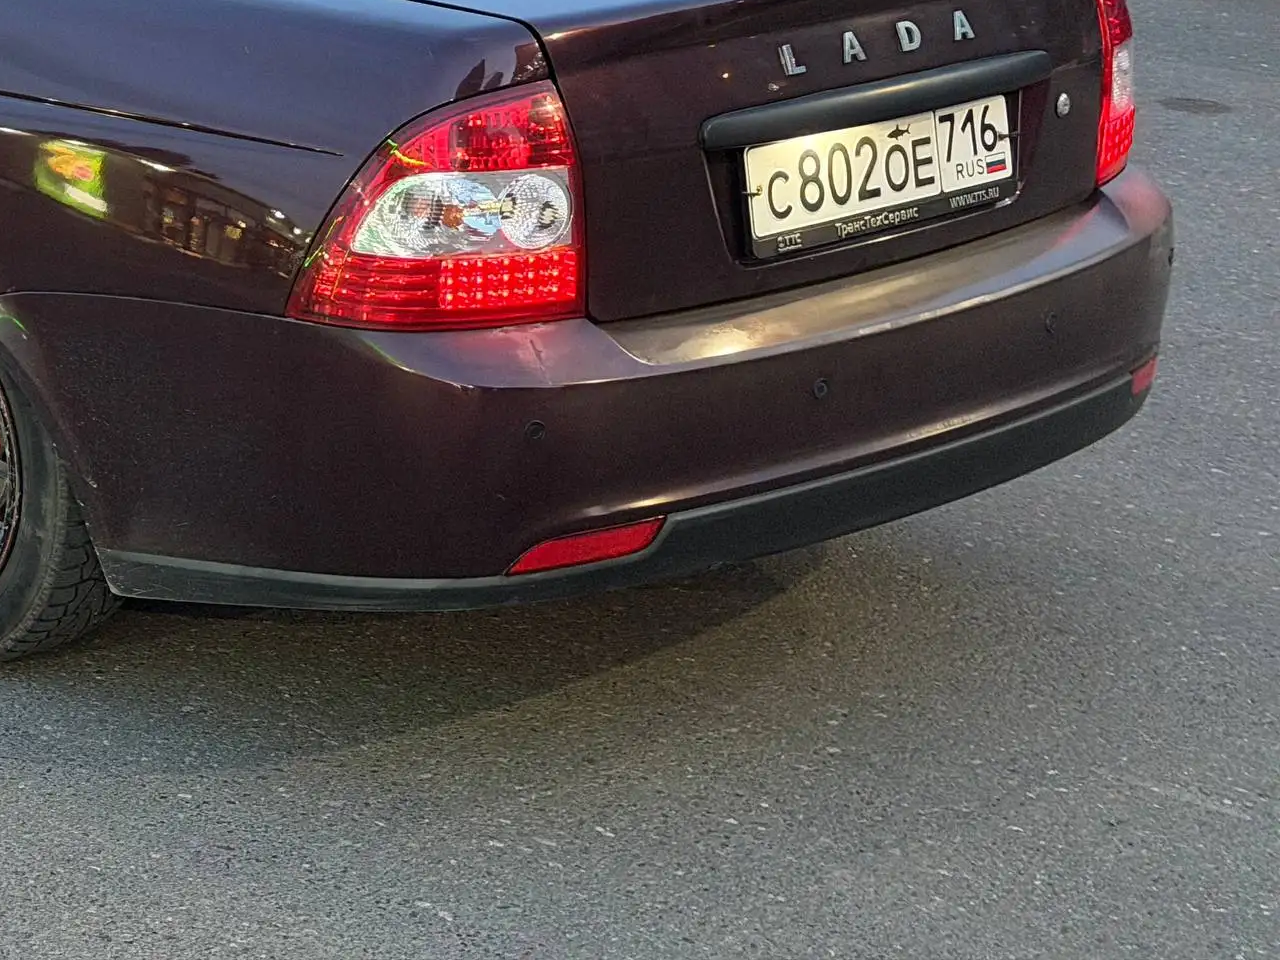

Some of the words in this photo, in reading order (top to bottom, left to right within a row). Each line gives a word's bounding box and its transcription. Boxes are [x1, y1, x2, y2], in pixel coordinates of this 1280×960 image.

[778, 10, 976, 76] LADA
[938, 104, 999, 163] 716
[955, 158, 986, 181] RUS
[834, 207, 919, 239] ТрансТехСервис
